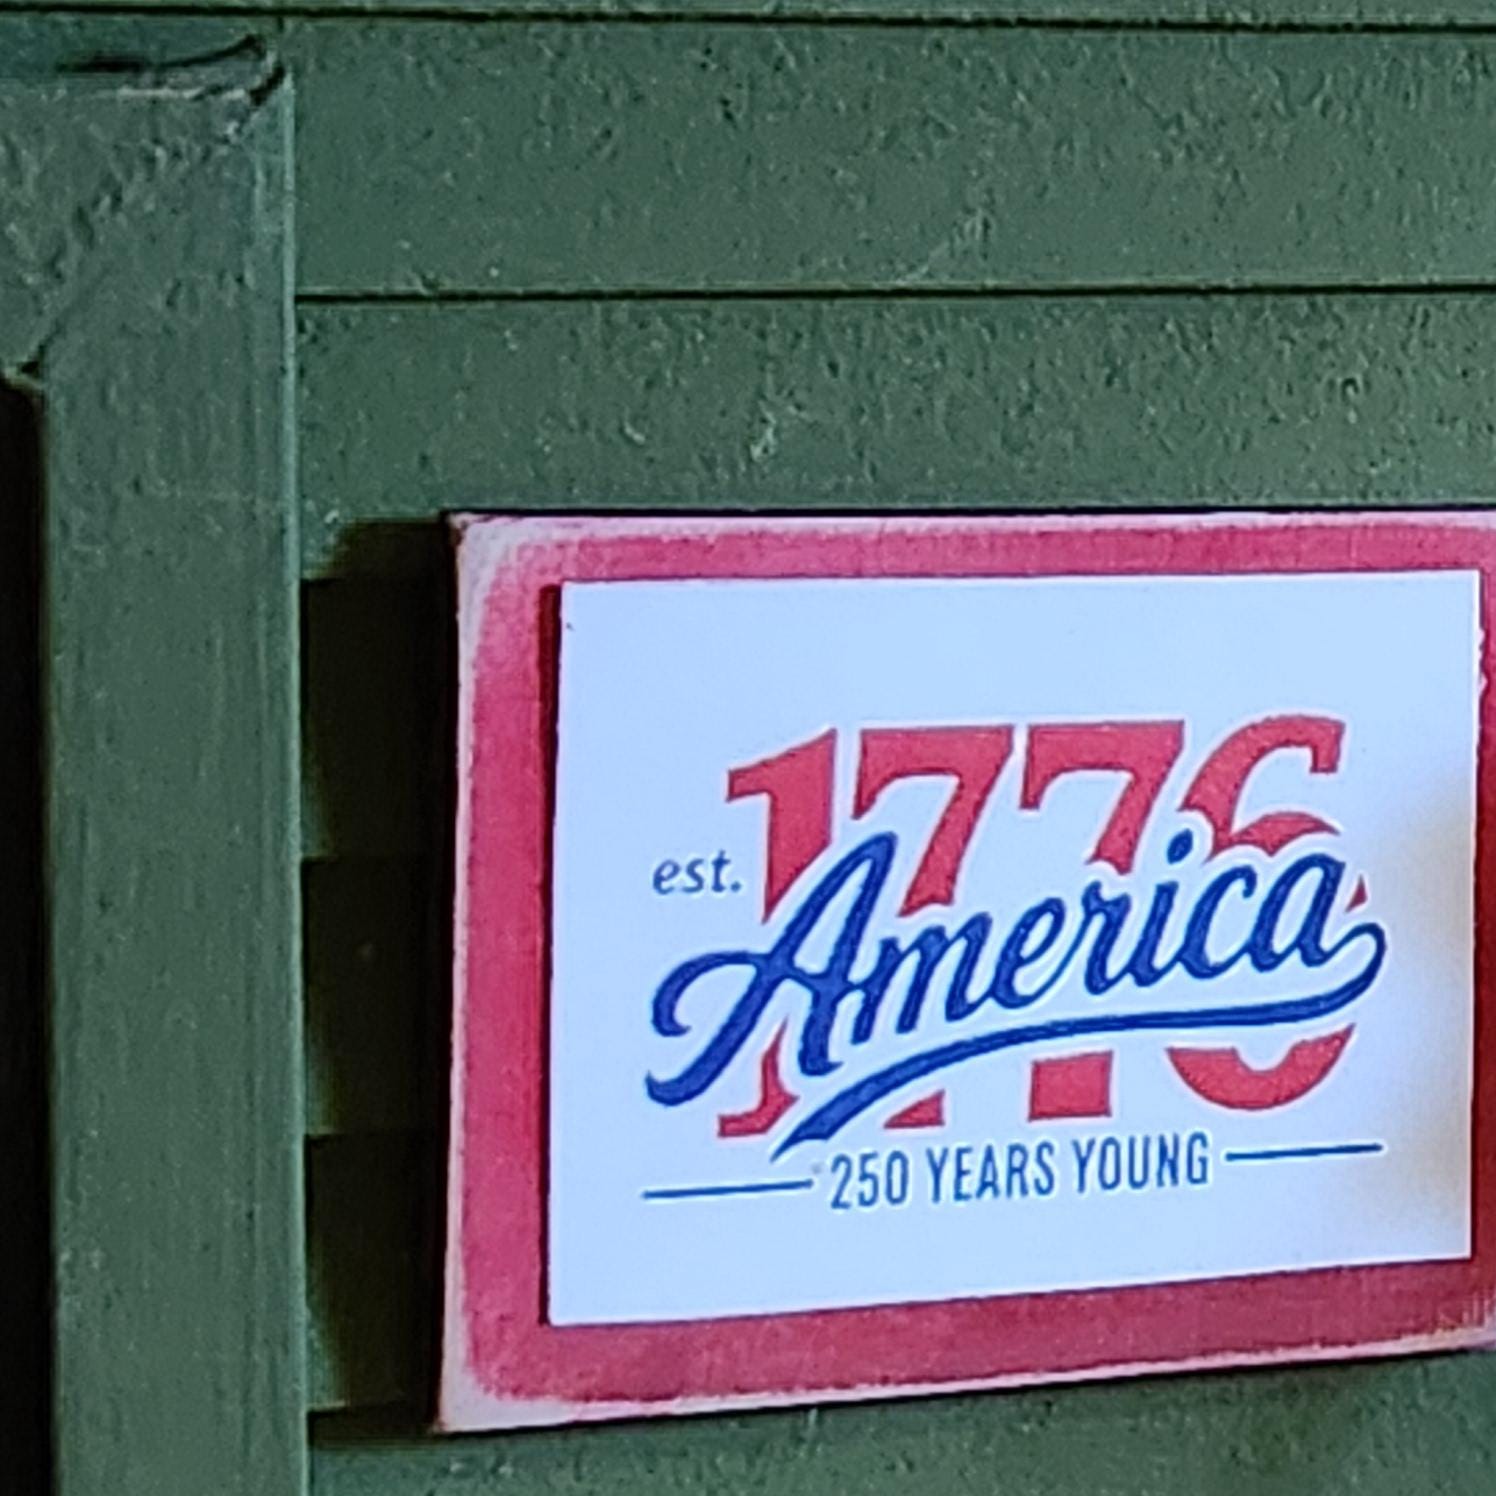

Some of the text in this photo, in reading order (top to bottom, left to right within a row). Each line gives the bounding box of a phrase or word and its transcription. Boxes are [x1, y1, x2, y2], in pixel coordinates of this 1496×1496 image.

[644, 828, 1388, 1162] America
[652, 713, 1368, 1138] est. 1776
[829, 1131, 1210, 1212] 250 YEARS YOUNG
